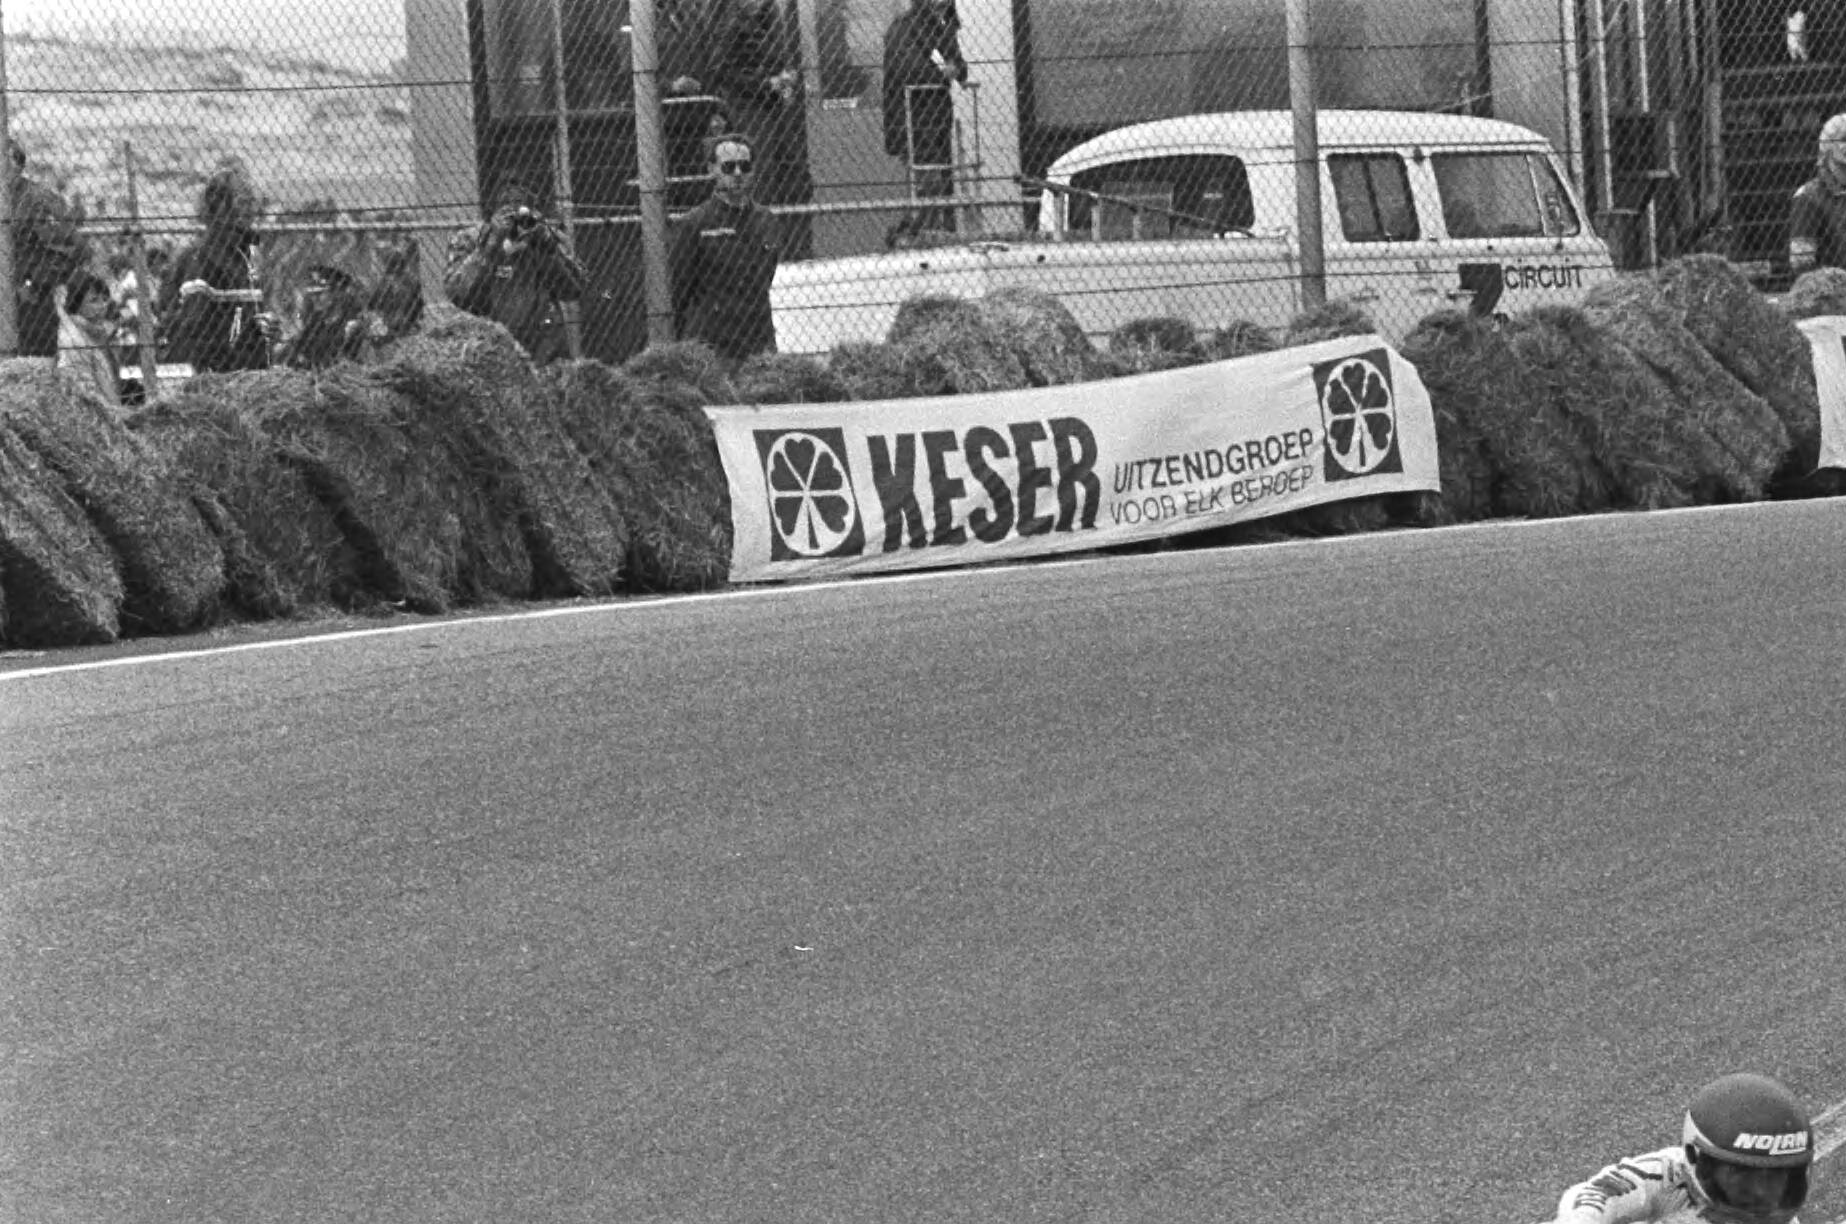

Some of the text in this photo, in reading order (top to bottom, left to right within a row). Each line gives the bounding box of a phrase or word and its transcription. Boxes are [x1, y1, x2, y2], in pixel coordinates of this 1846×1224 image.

[866, 416, 1101, 554] KESER
[1113, 427, 1314, 494] UITZENDGROEP
[1110, 464, 1314, 525] VOOR ELK BEROEP
[1732, 1131, 1808, 1156] NOLAN
